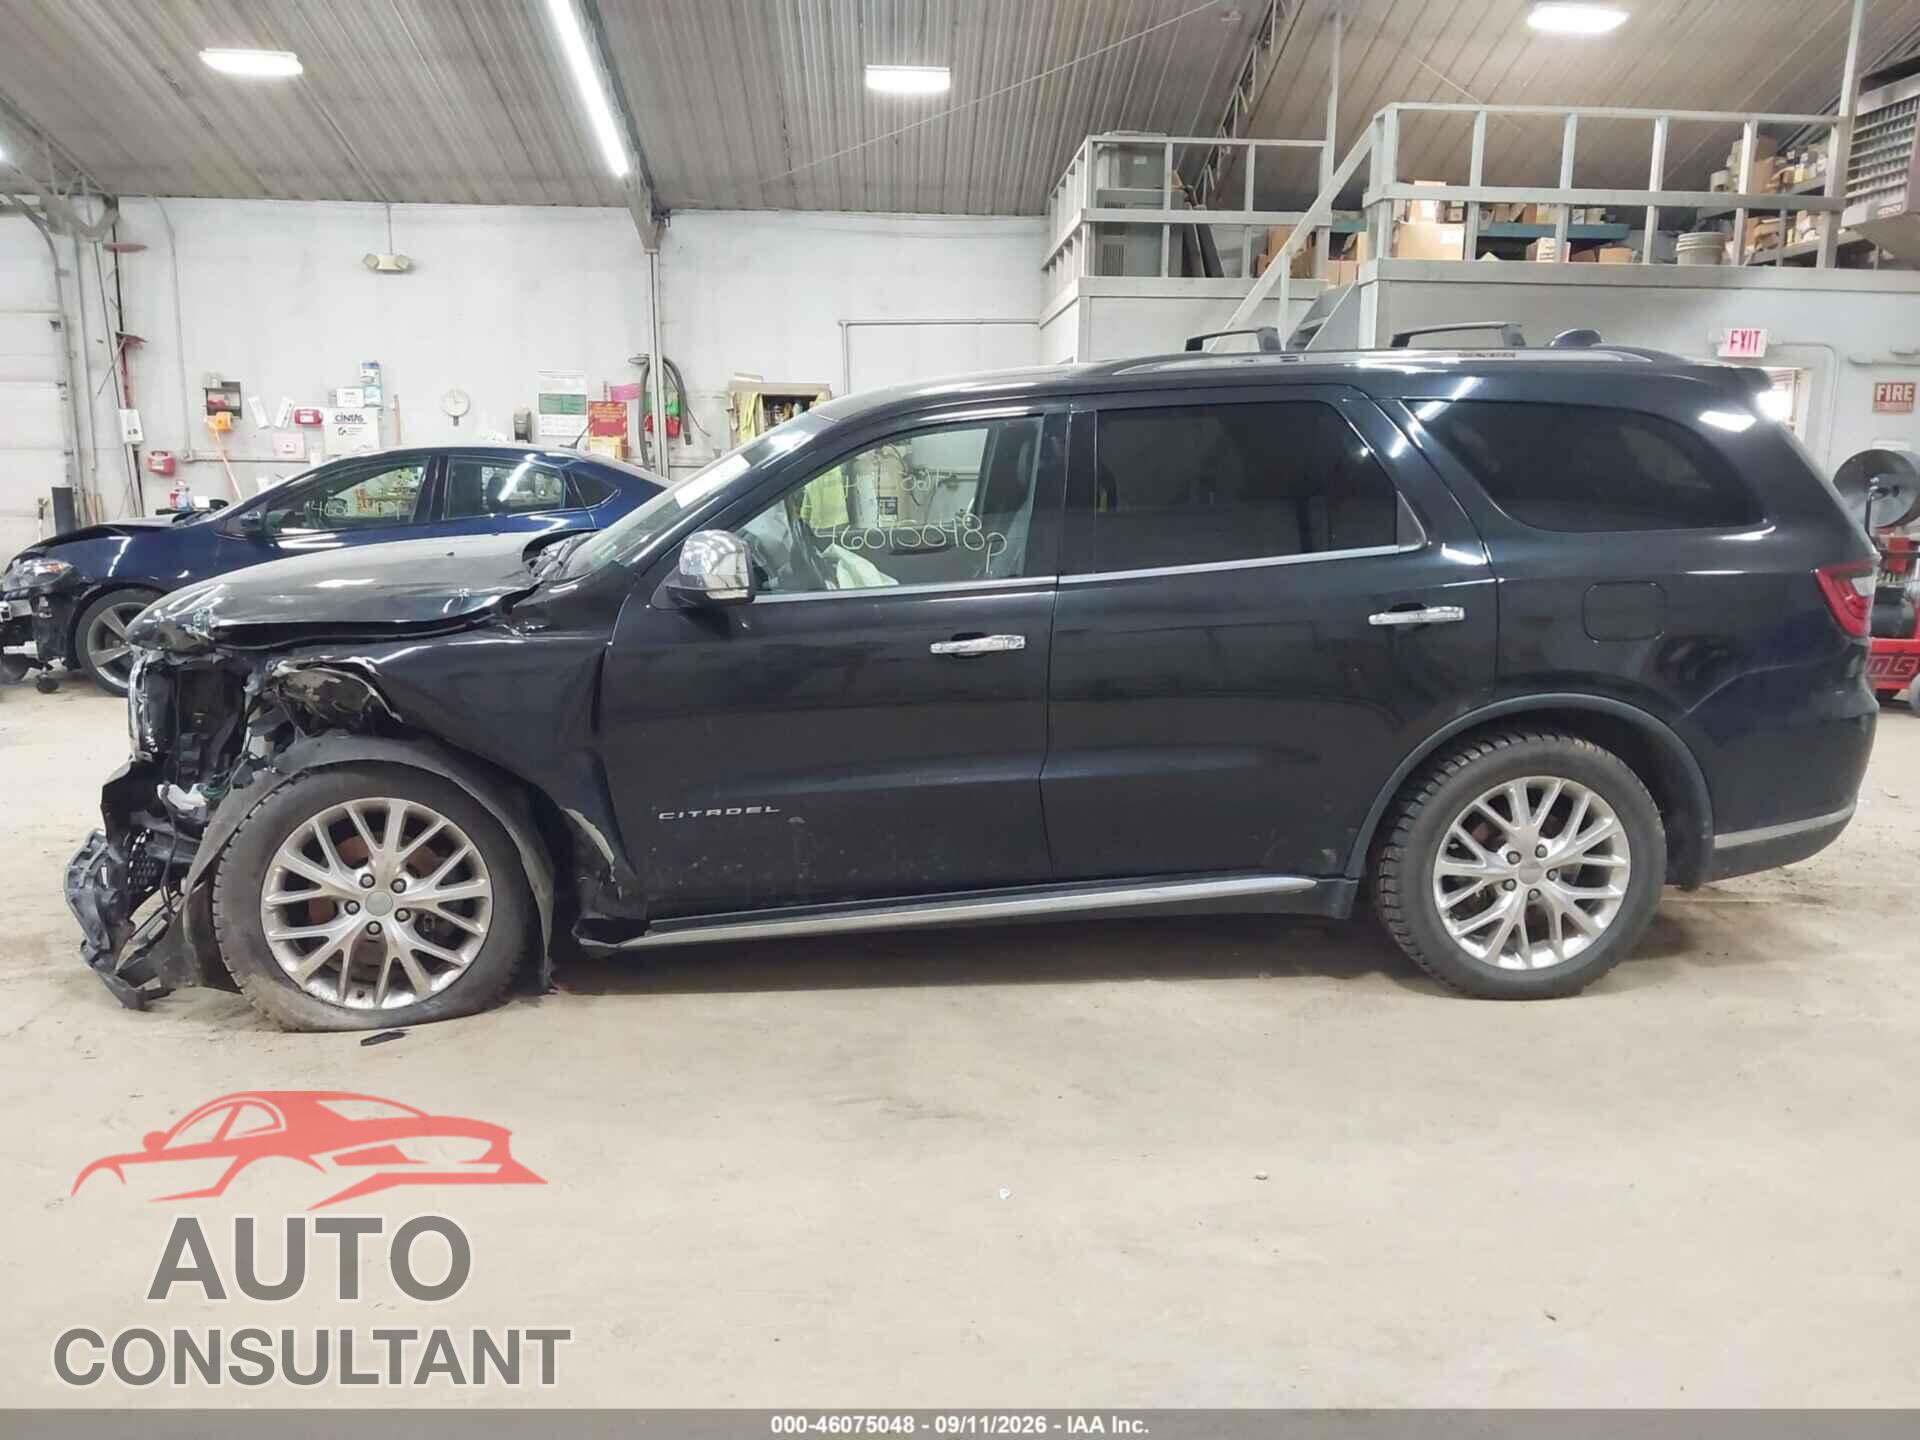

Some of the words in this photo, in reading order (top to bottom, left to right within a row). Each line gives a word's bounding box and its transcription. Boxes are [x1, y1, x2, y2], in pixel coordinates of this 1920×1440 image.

[1730, 330, 1761, 352] EXIT
[1876, 383, 1913, 401] FIRE
[658, 805, 780, 820] CITADEL
